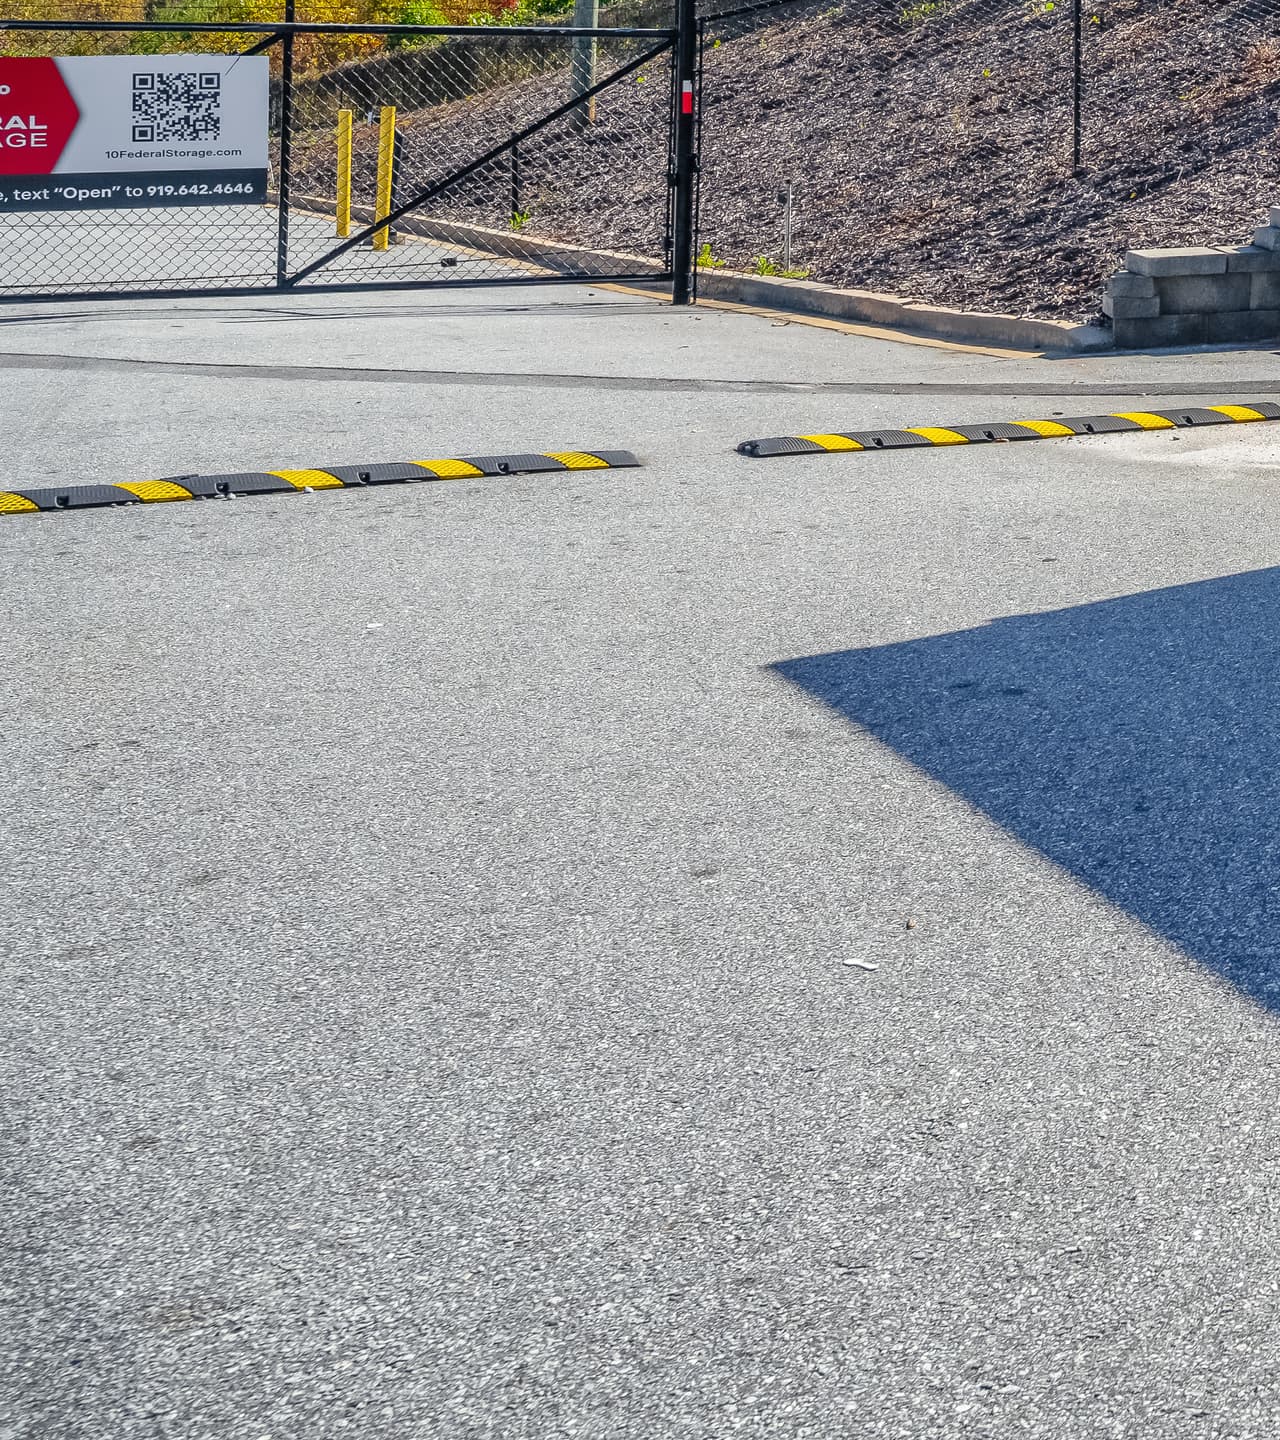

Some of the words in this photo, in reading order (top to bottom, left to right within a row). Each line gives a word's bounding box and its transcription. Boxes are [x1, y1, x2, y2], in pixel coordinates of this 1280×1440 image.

[0, 115, 48, 130] AL
[0, 133, 48, 148] GE
[105, 148, 242, 159] 10FederalStorage.com
[13, 188, 50, 201] text
[125, 185, 143, 197] to
[147, 183, 254, 196] 919.642.4646
